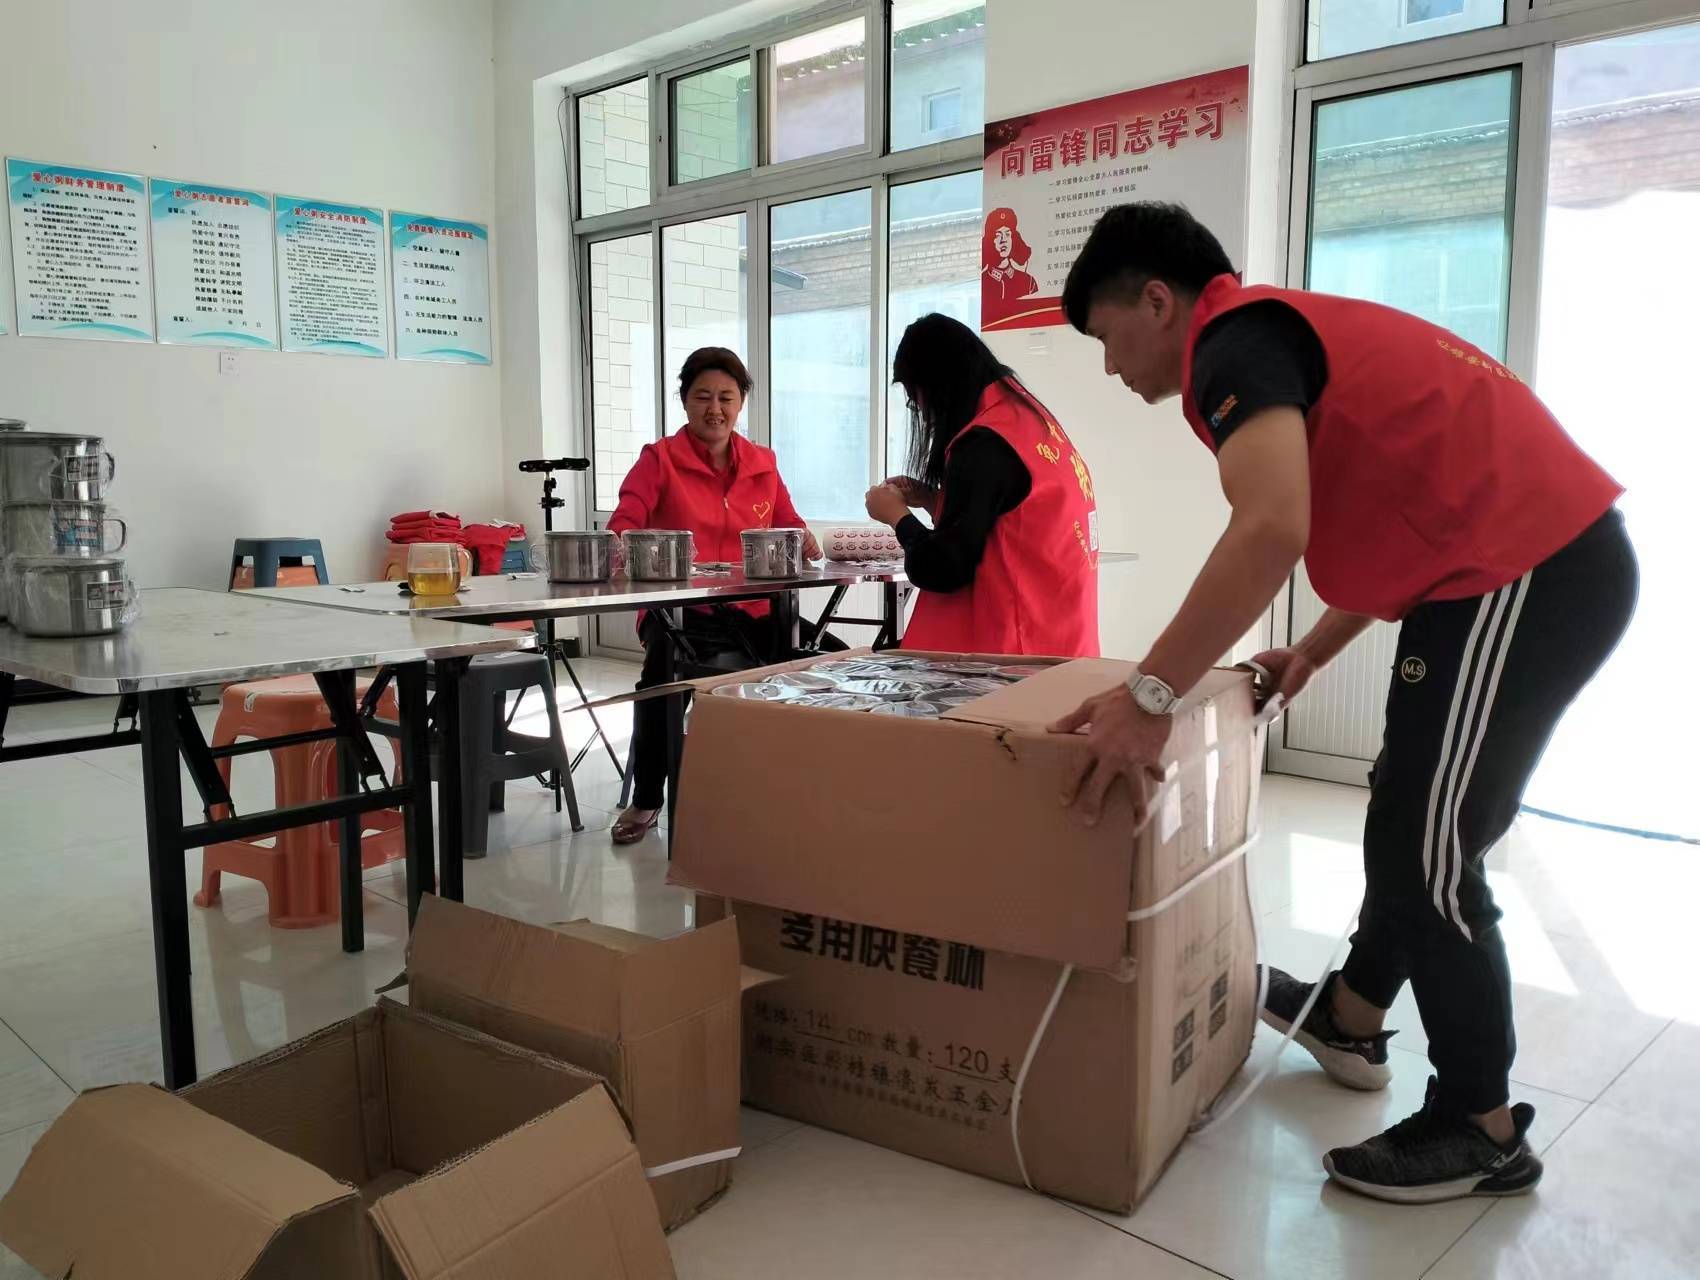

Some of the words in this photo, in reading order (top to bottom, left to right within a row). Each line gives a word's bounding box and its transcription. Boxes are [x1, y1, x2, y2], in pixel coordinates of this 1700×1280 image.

[1000, 102, 1226, 179] 向雷锋同志学习
